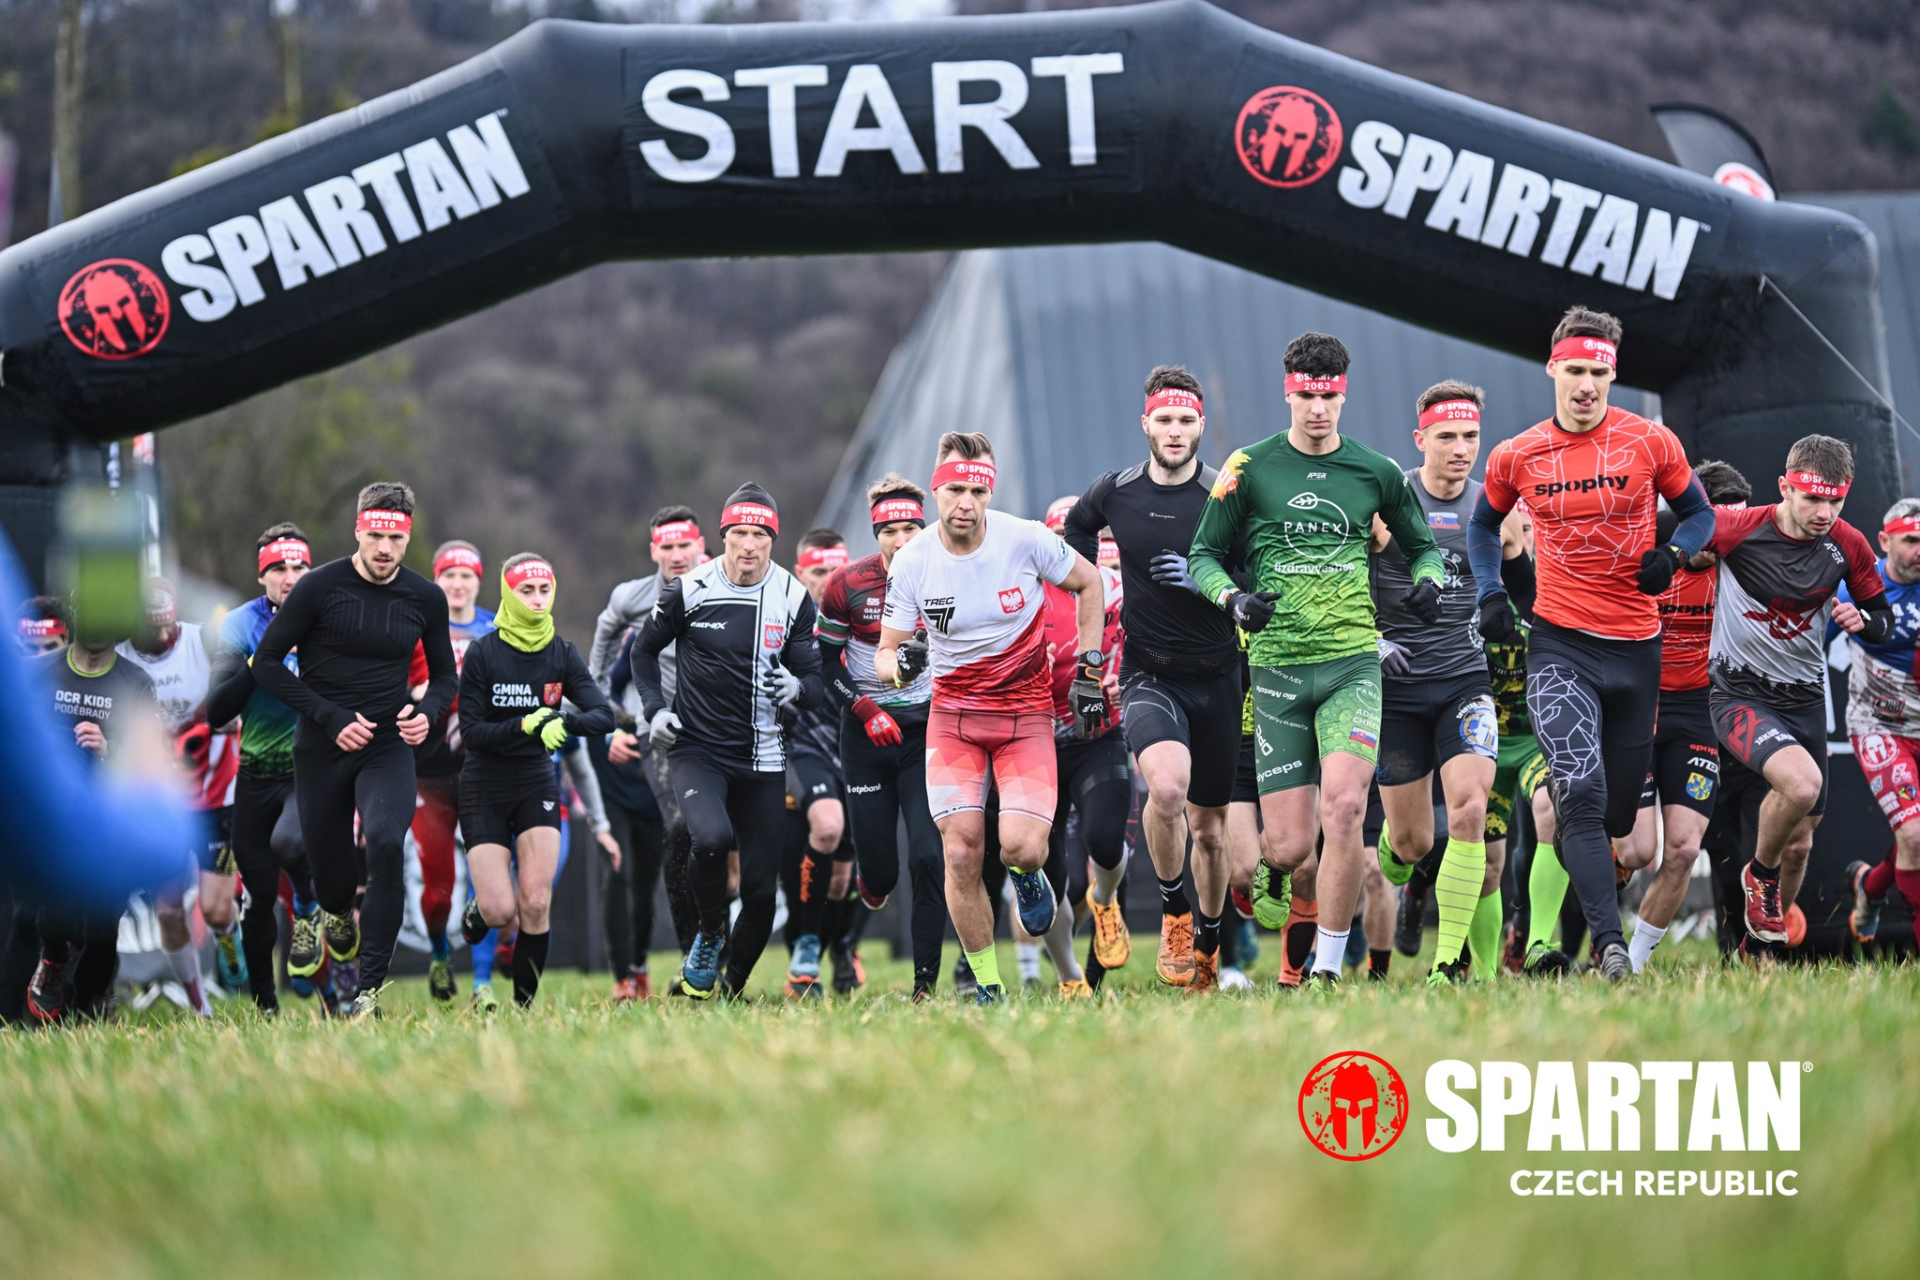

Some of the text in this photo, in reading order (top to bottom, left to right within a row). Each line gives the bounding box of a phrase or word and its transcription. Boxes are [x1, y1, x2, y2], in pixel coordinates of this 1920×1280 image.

[639, 52, 1125, 183] START
[1337, 120, 1701, 302] SPARTAN
[160, 112, 531, 323] SPARTAN
[1304, 382, 1331, 390] 2063
[1168, 397, 1193, 407] 2135
[1447, 410, 1473, 419] 2094
[1306, 472, 1327, 480] APER
[1534, 474, 1629, 497] spophy
[1811, 485, 1838, 496] 2086
[740, 515, 765, 525] 2070
[888, 511, 912, 519] 2043
[370, 520, 396, 529] 2210
[1284, 522, 1342, 534] PANEX
[1823, 542, 1845, 565] APER
[923, 596, 955, 607] TREC
[492, 683, 532, 696] GMINA
[55, 690, 112, 708] OCR KIDS
[491, 695, 540, 707] CZARNA
[1282, 692, 1298, 701] Bio
[54, 703, 112, 720] PODĚBRADY
[1754, 728, 1780, 746] JAKUB
[851, 783, 882, 795] otpbank
